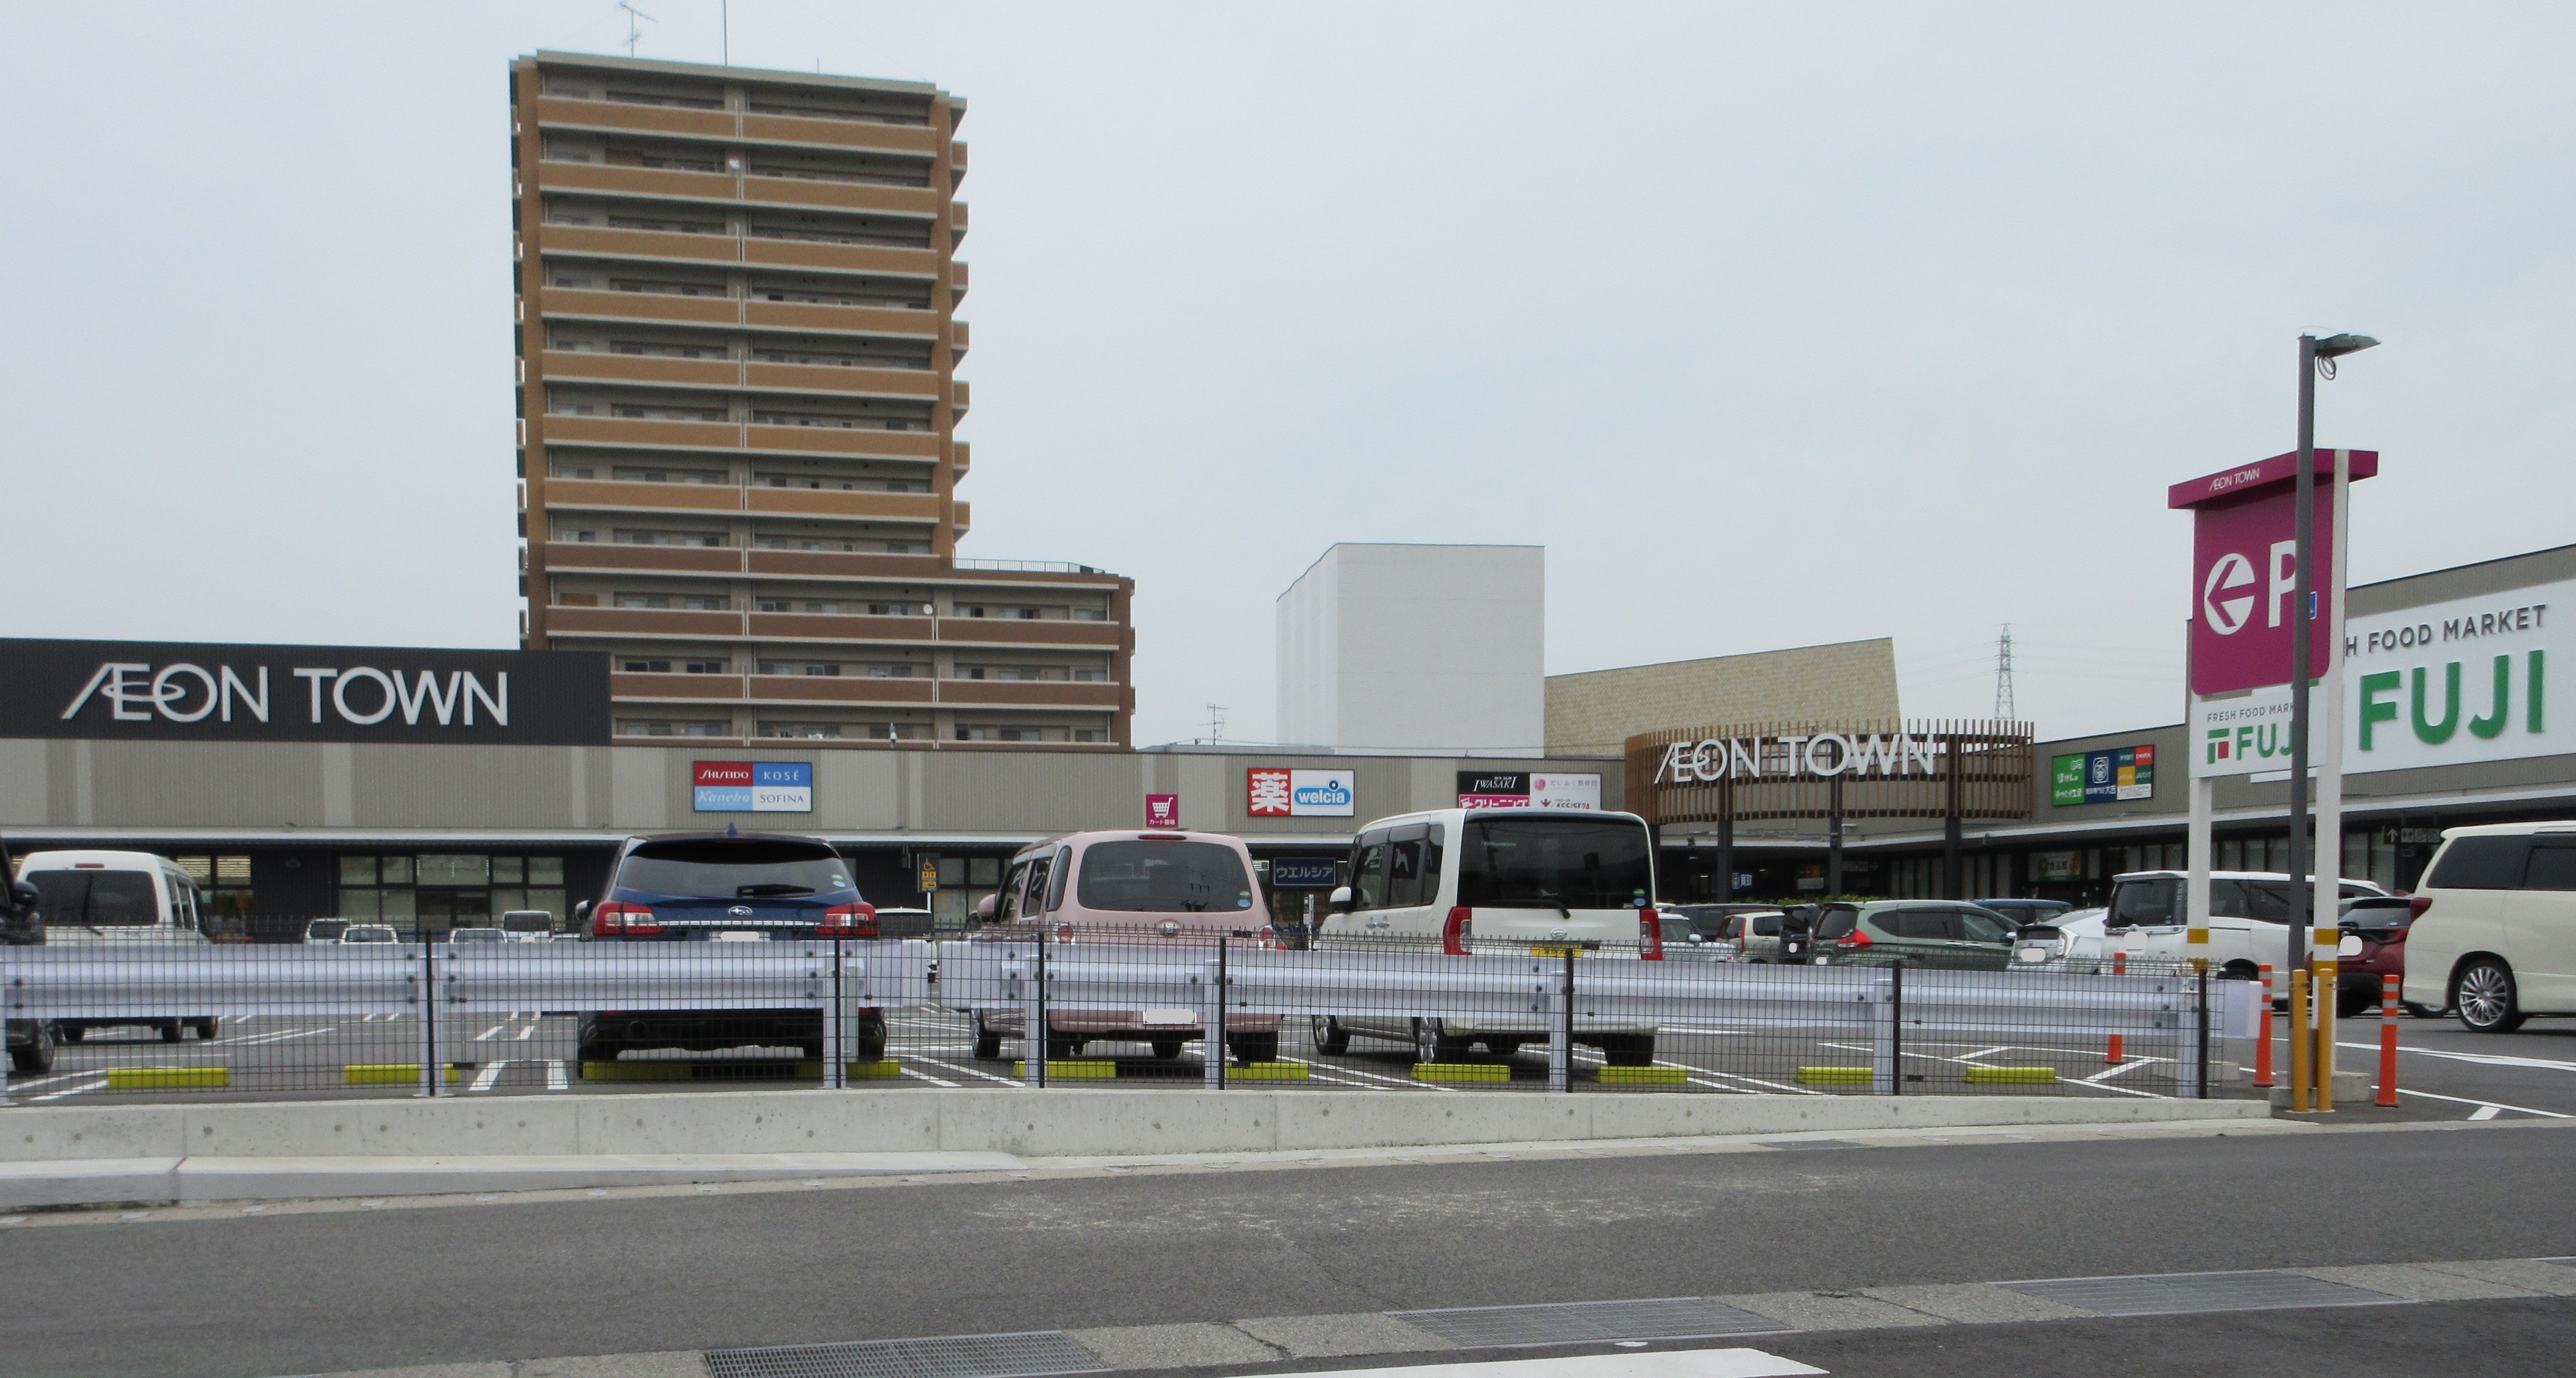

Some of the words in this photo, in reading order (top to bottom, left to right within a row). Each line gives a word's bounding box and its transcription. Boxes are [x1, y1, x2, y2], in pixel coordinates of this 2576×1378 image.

[2234, 467, 2260, 485] TOWN
[2268, 540, 2296, 628] P
[2368, 624, 2432, 653] FOOD
[2443, 603, 2546, 641] MARKET
[293, 666, 508, 726] TOWN
[2359, 649, 2544, 752] FUJI
[2207, 710, 2237, 723] FRESH
[2239, 706, 2265, 719] FOOD
[2236, 720, 2293, 761] FUJ
[1777, 732, 1934, 777] TOWN
[699, 769, 749, 779] SHISEIDO
[764, 769, 799, 781] KOSÉ
[1250, 772, 1289, 812] 薬
[1473, 776, 1517, 792] IWASAKI
[698, 790, 750, 803] Kanebo
[760, 795, 804, 803] SOFINA
[1298, 787, 1345, 804] welcia
[1276, 866, 1334, 878] ウエルシア
